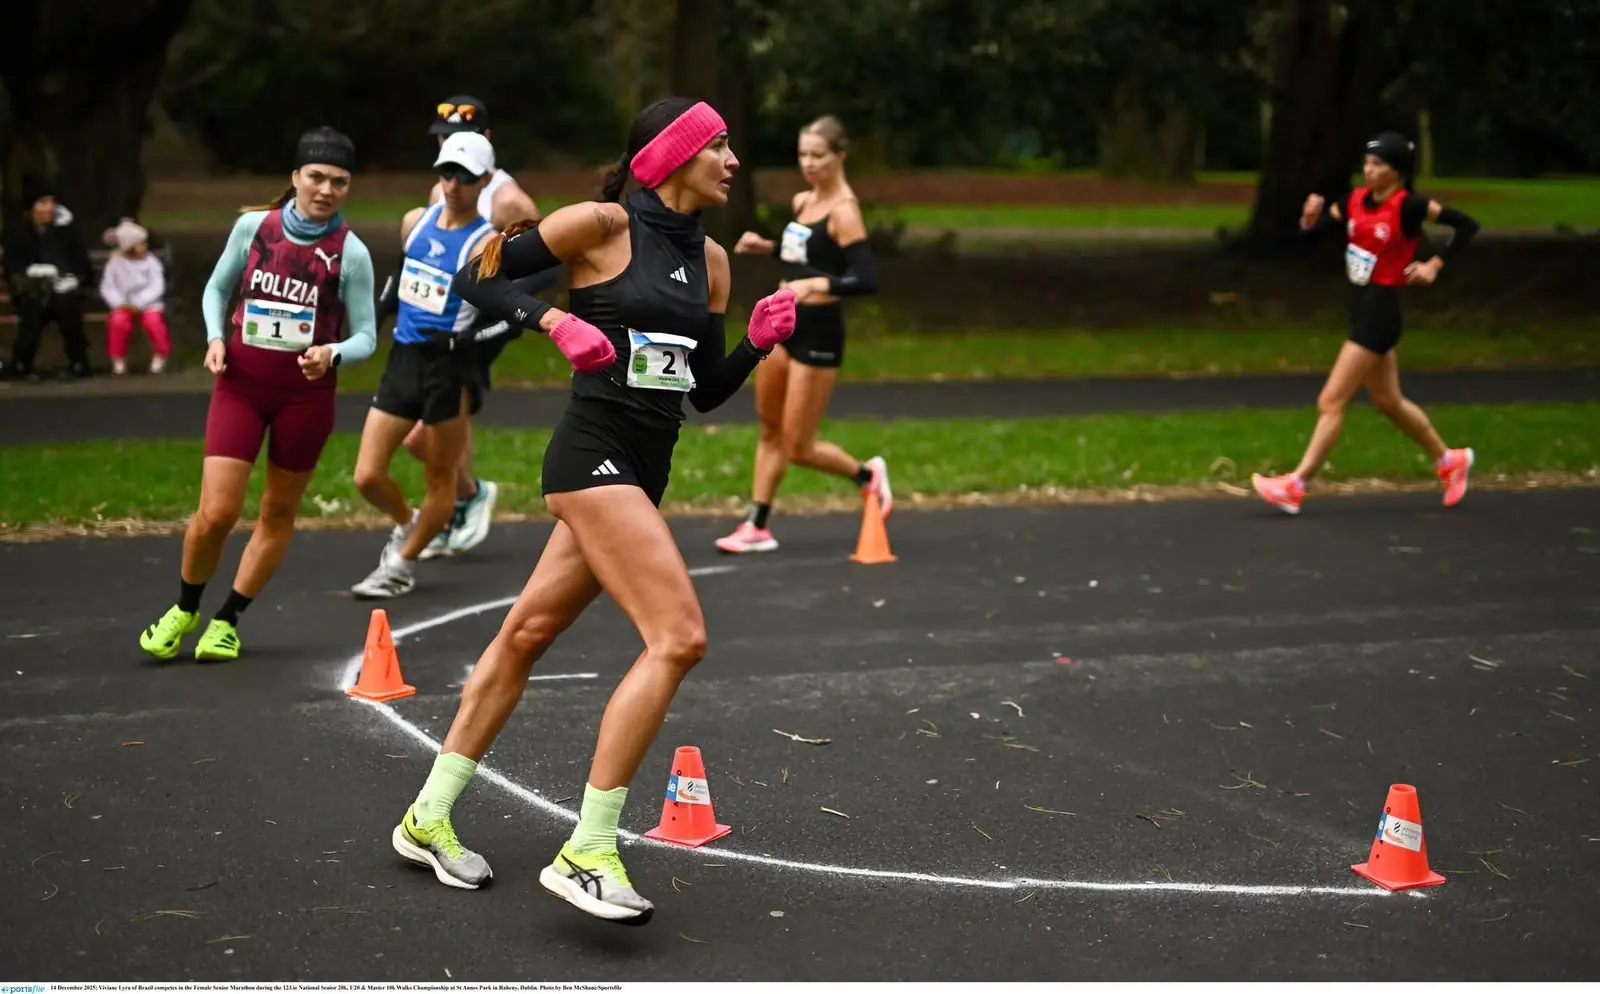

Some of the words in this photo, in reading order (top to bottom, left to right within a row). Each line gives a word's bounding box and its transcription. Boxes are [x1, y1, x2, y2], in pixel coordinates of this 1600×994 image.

[250, 269, 319, 306] POLIZIA
[410, 280, 431, 298] 43
[271, 321, 283, 339] 1
[662, 351, 676, 375] 2
